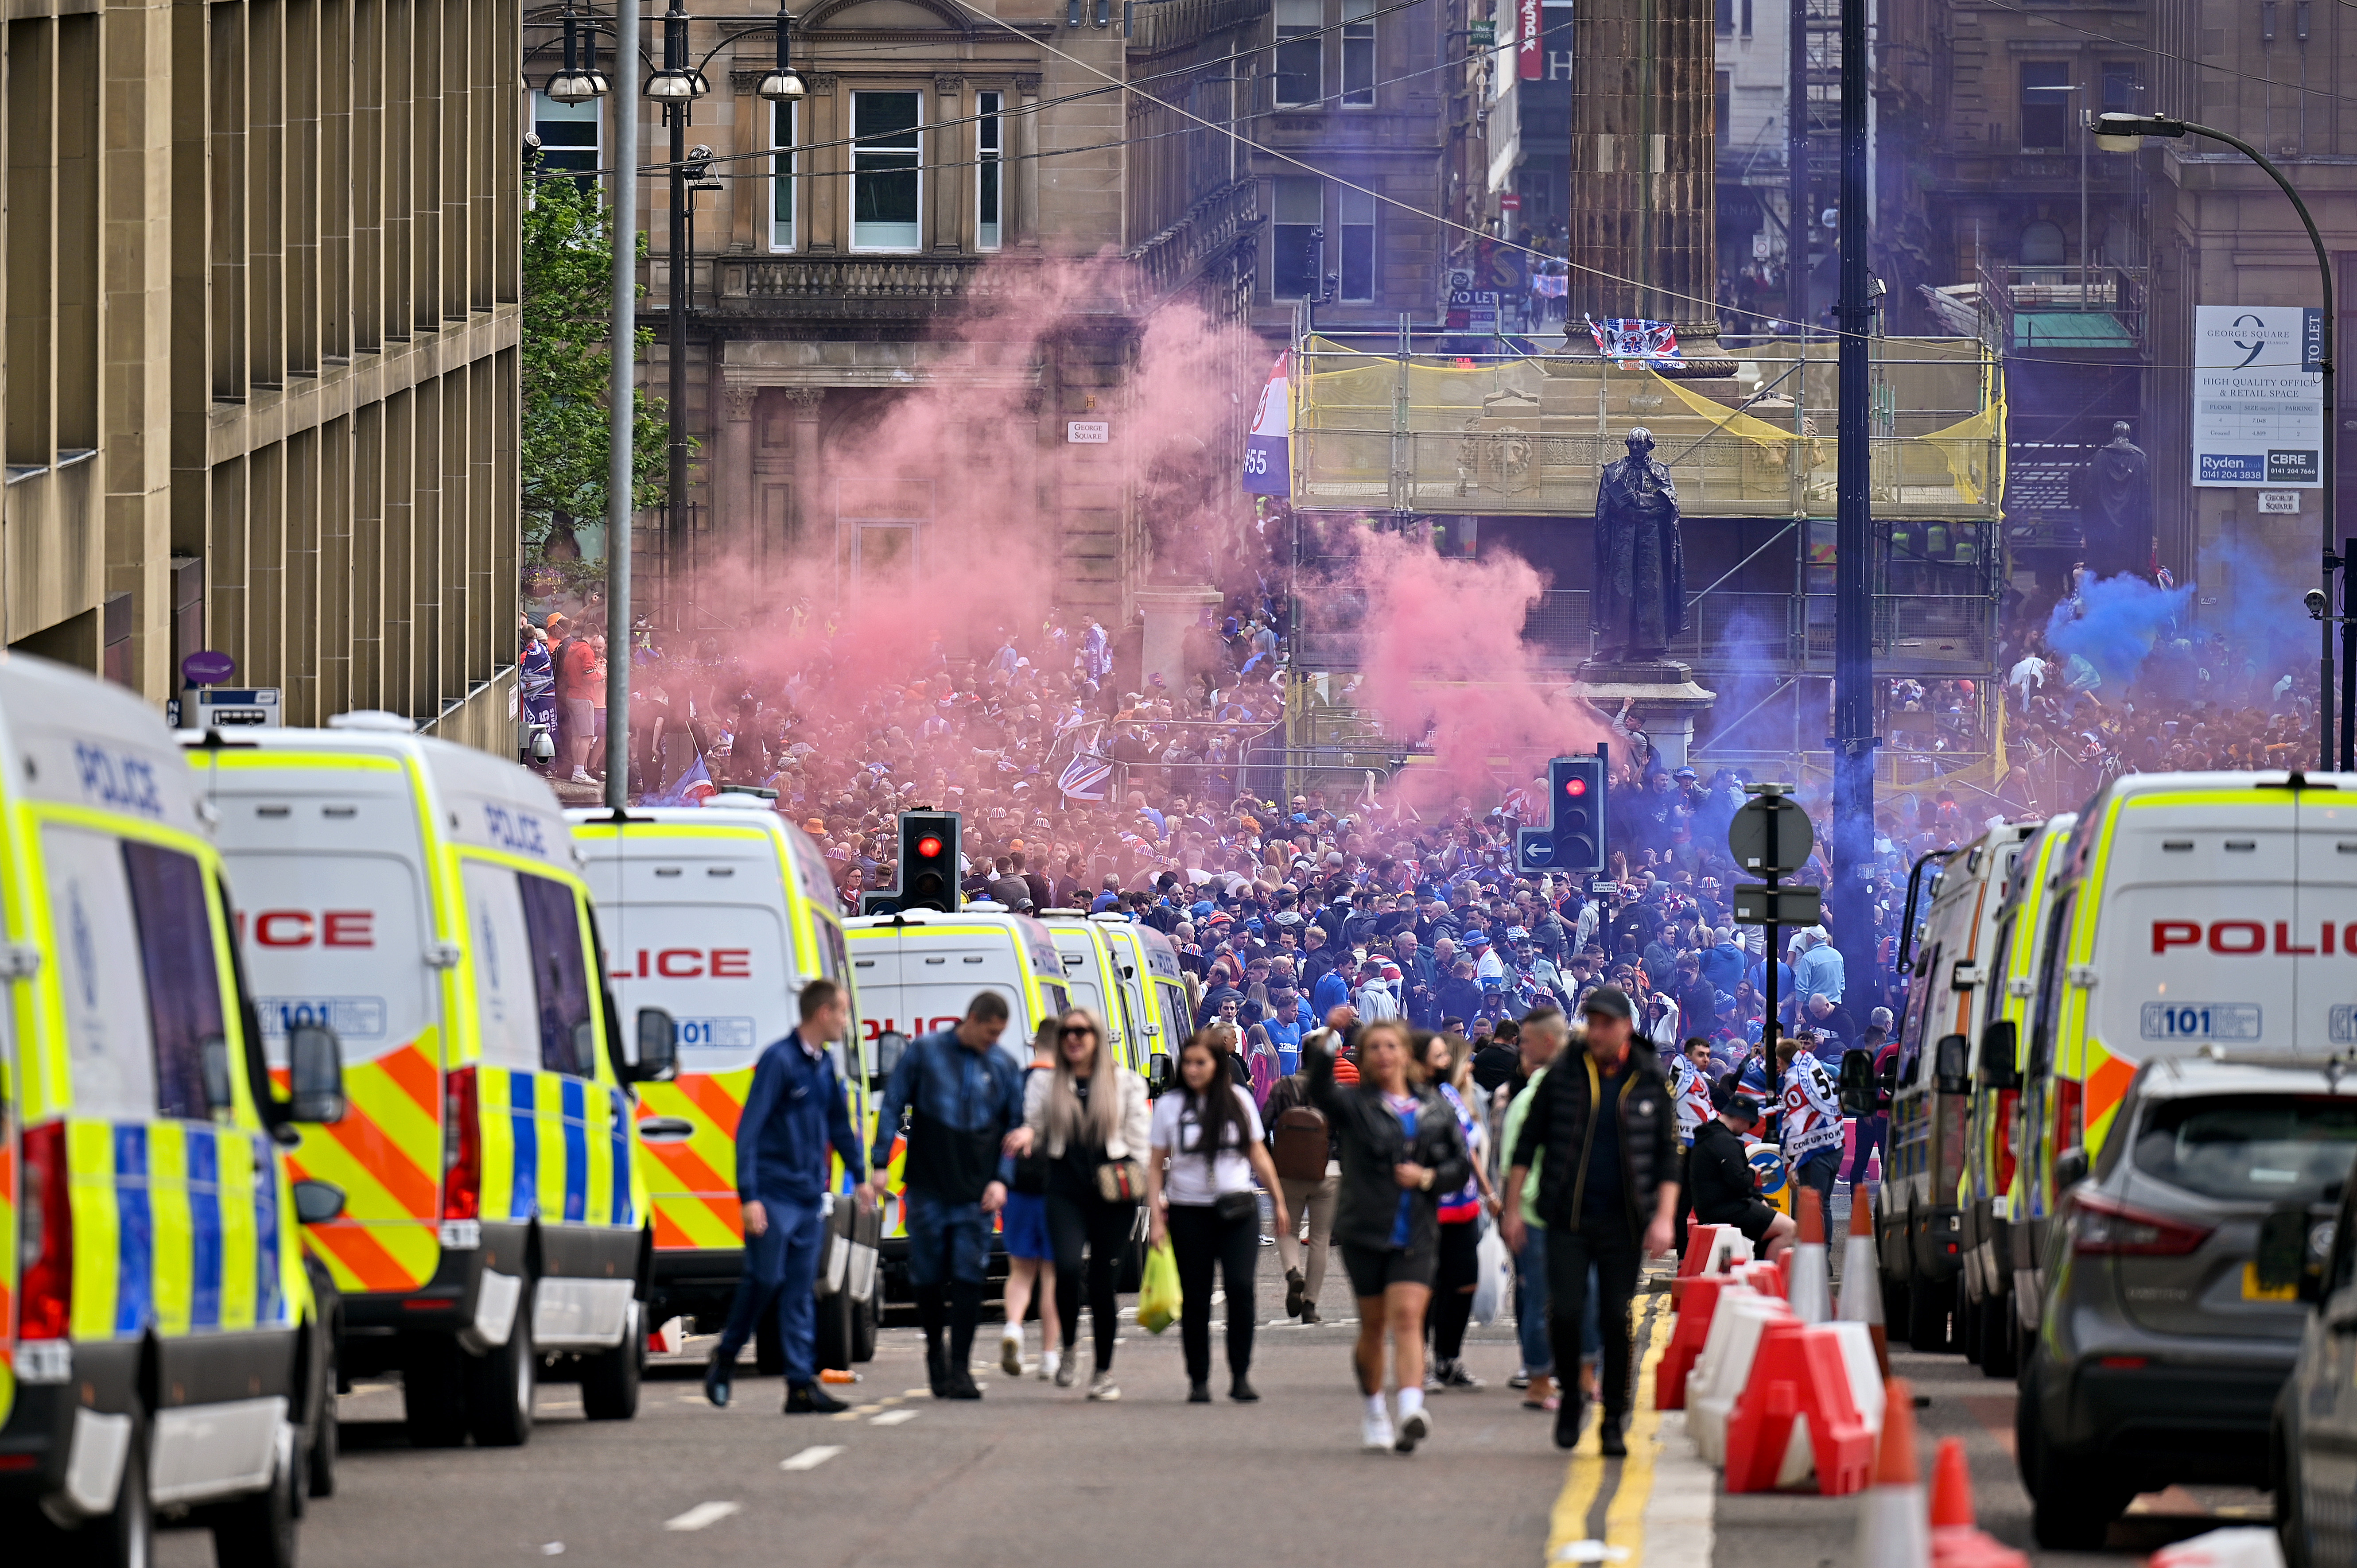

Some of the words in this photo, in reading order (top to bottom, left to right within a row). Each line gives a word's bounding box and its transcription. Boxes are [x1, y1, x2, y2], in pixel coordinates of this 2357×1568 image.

[1477, 58, 1486, 139] HOTEL
[1452, 291, 1470, 303] TO
[1476, 291, 1498, 304] LET
[2309, 315, 2320, 342] LET
[1622, 340, 1642, 353] 55
[2308, 345, 2320, 364] TO
[2271, 454, 2306, 465] CBRE
[74, 739, 164, 814] POLICE
[484, 803, 548, 857] POLICE
[239, 909, 375, 948] ICE
[2151, 920, 2357, 955] POLI
[608, 949, 752, 978] LICE
[1156, 952, 1175, 977] POLICE
[2165, 1008, 2211, 1035] 101
[1810, 1135, 1821, 1144] UP
[1823, 1131, 1834, 1141] TO
